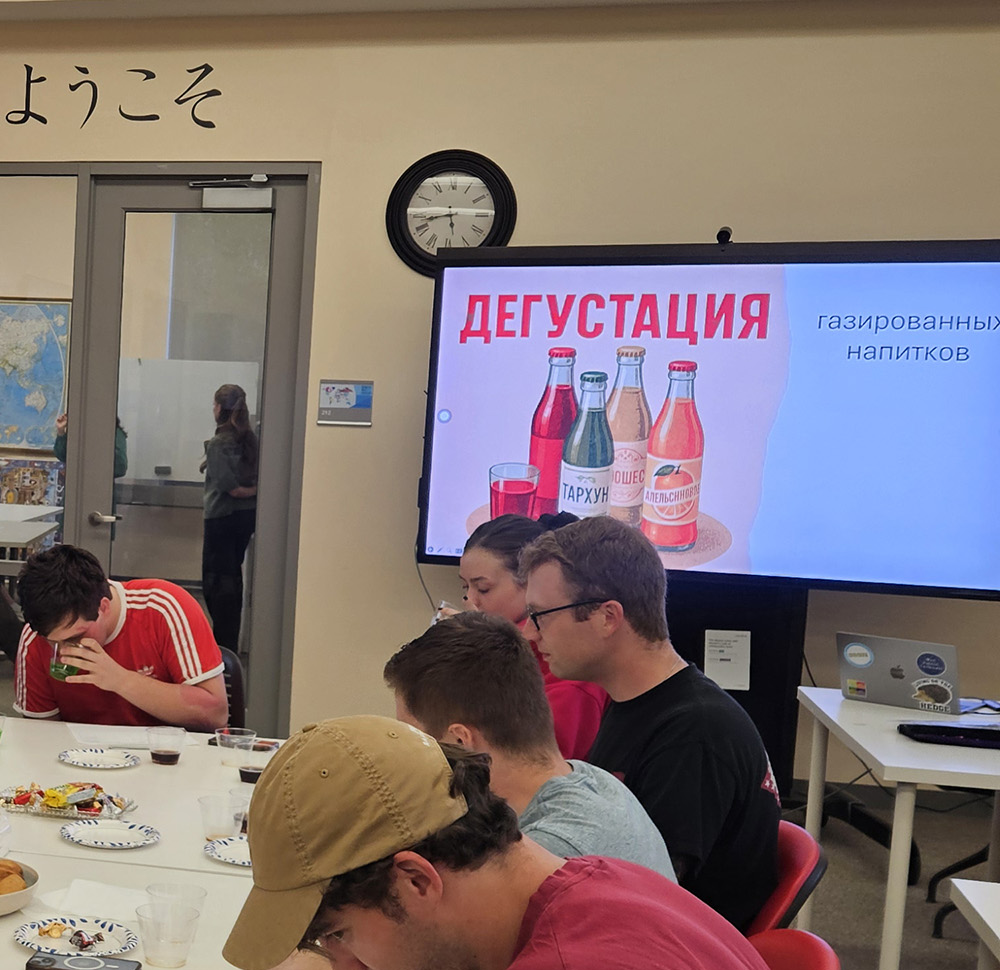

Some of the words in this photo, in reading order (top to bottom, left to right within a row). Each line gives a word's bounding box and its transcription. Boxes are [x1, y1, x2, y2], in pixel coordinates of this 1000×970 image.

[5, 62, 222, 130] ようこそ
[459, 293, 771, 345] ДЕГУСТАЦИЯ
[847, 345, 970, 362] напитков
[562, 482, 609, 504] ТАРХУН
